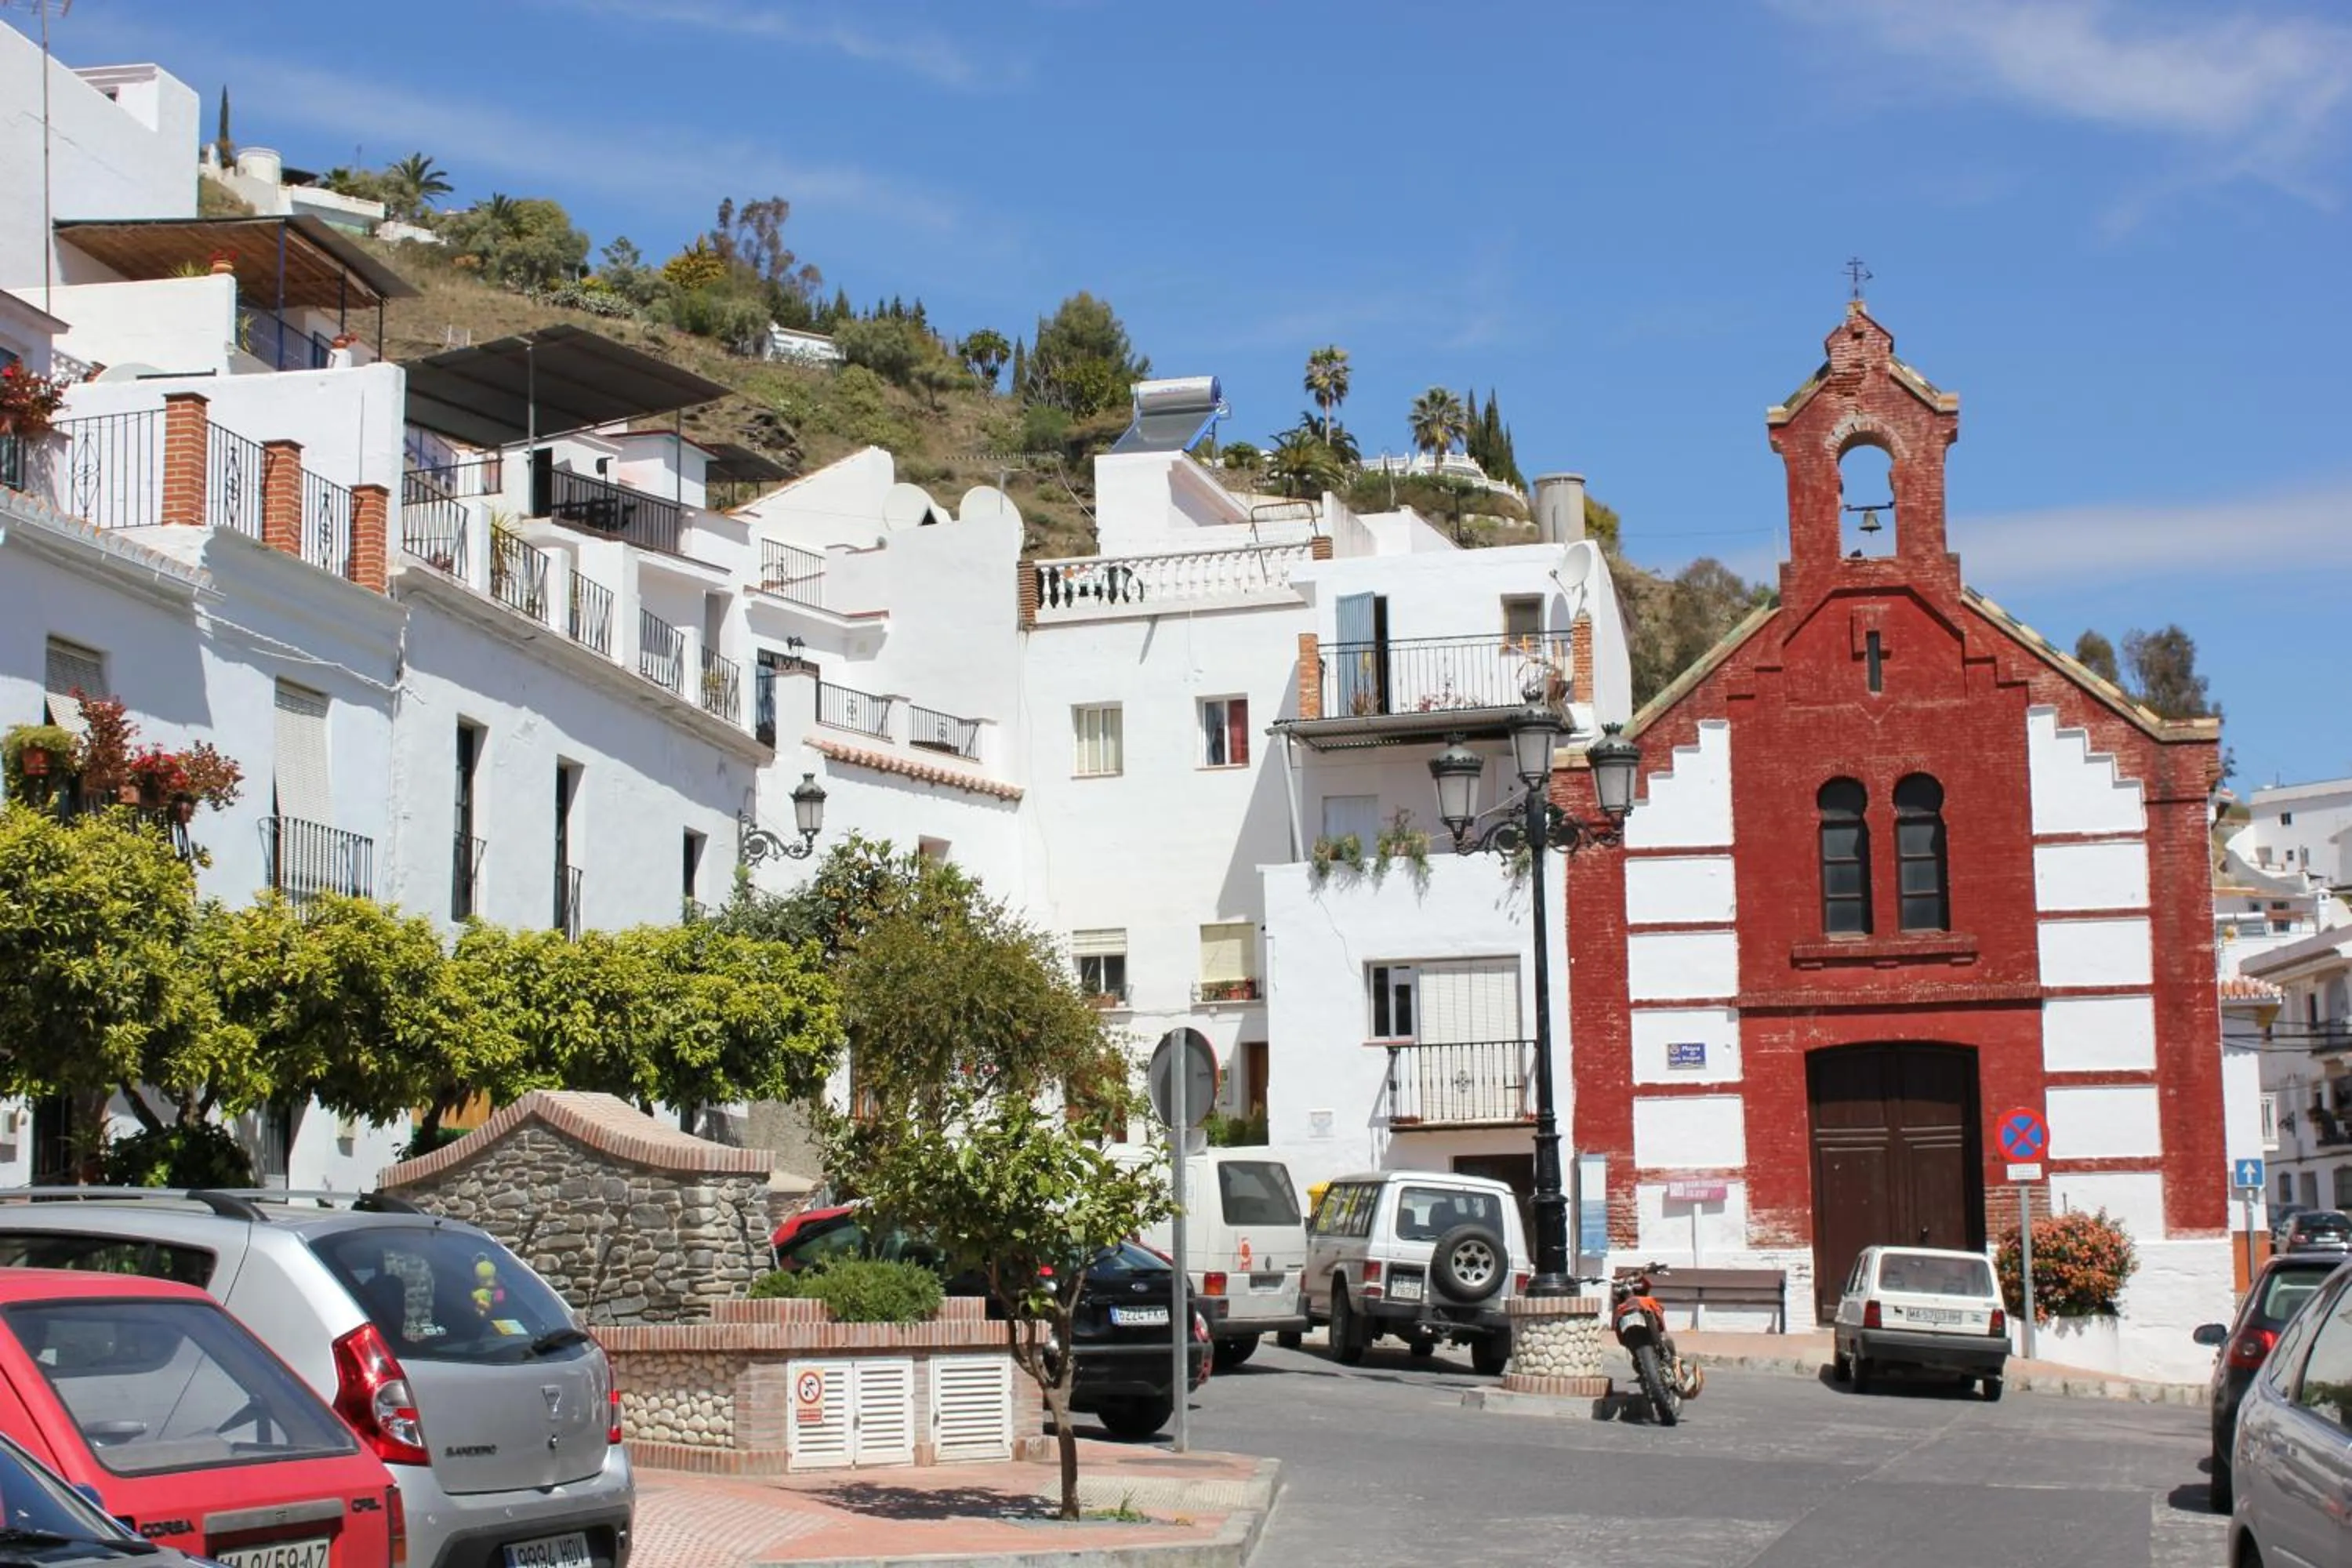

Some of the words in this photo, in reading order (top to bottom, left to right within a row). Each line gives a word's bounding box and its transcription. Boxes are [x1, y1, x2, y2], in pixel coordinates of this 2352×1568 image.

[445, 1444, 497, 1457] SANDERO
[350, 1497, 382, 1512] OPEL
[140, 1519, 195, 1537] CORSA
